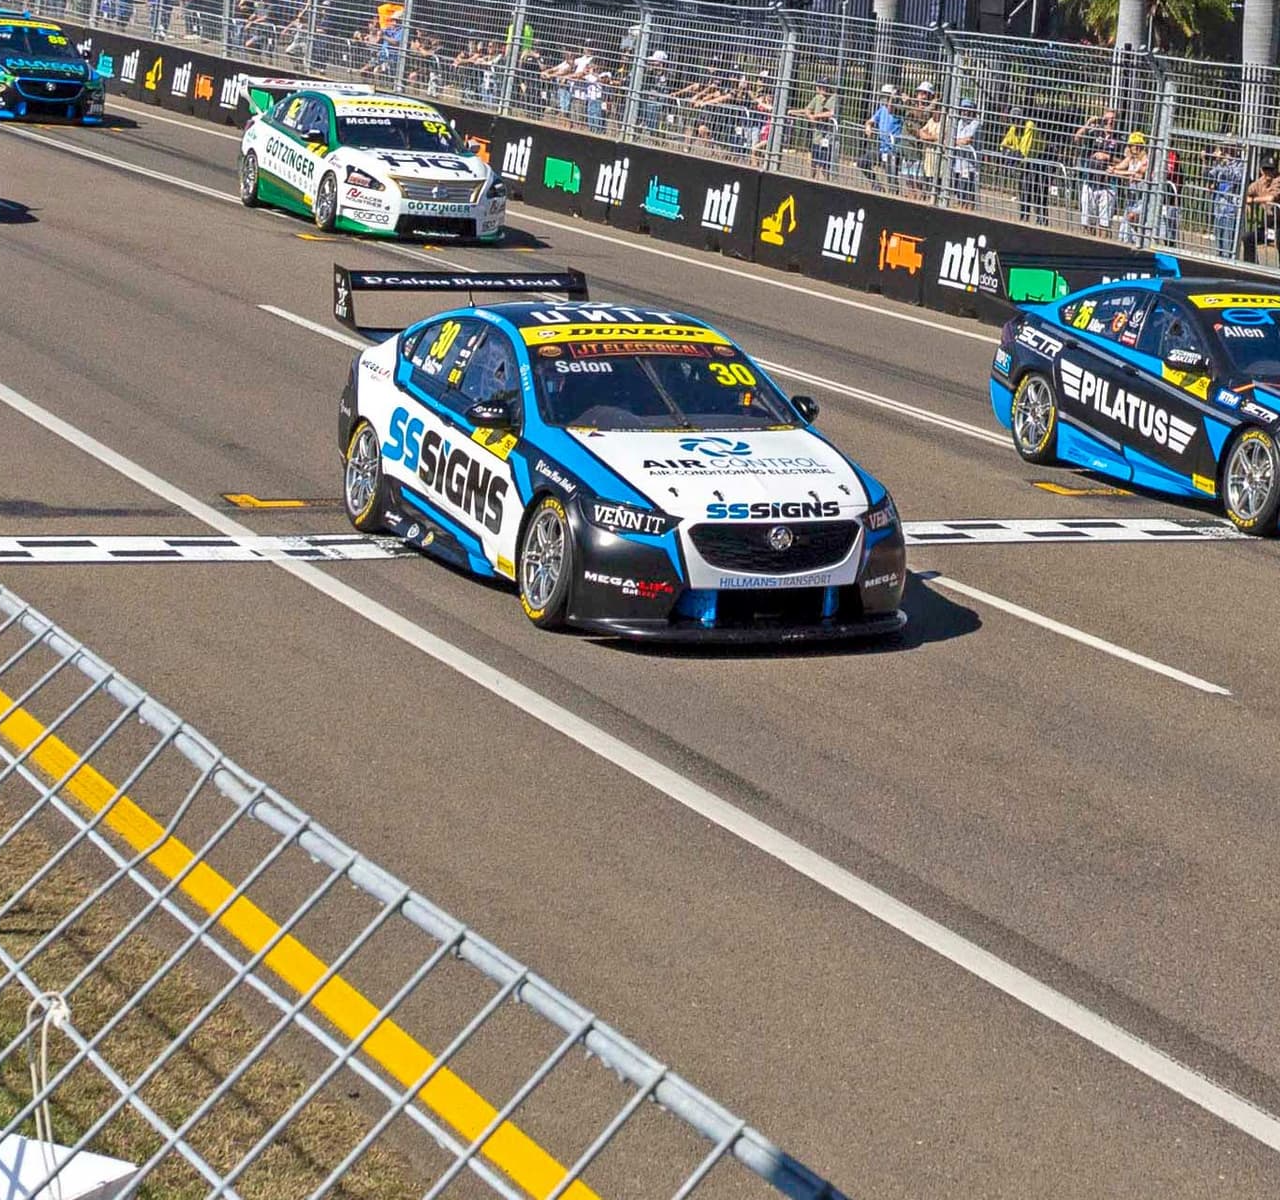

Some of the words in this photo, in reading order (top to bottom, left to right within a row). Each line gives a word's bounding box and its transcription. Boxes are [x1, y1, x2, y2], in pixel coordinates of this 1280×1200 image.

[122, 49, 139, 80] nti
[173, 61, 192, 92] nti
[346, 117, 391, 126] McLeod
[423, 121, 450, 136] 92
[502, 136, 533, 177] nti
[597, 158, 629, 201] nti
[704, 181, 741, 227] nti
[354, 211, 390, 224] sparco
[825, 208, 864, 257] nti
[939, 235, 986, 286] nti
[452, 277, 504, 287] Plaza
[507, 278, 562, 288] Hotel
[430, 320, 462, 360] 30
[568, 328, 705, 337] DUNLOP
[1018, 325, 1063, 357] SCTR
[1223, 326, 1264, 339] Allen
[577, 344, 597, 355] JT
[603, 344, 698, 356] ELECTRICAL
[555, 360, 614, 373] Seton
[708, 362, 757, 387] 30
[1080, 370, 1169, 445] PILATUS
[1244, 402, 1279, 422] SCTR
[642, 459, 707, 469] AIR
[710, 456, 827, 469] CONTROL
[769, 468, 836, 476] ELECTRICAL
[593, 505, 642, 531] VENN
[644, 514, 666, 534] IT
[777, 574, 832, 586] TRANSPORT
